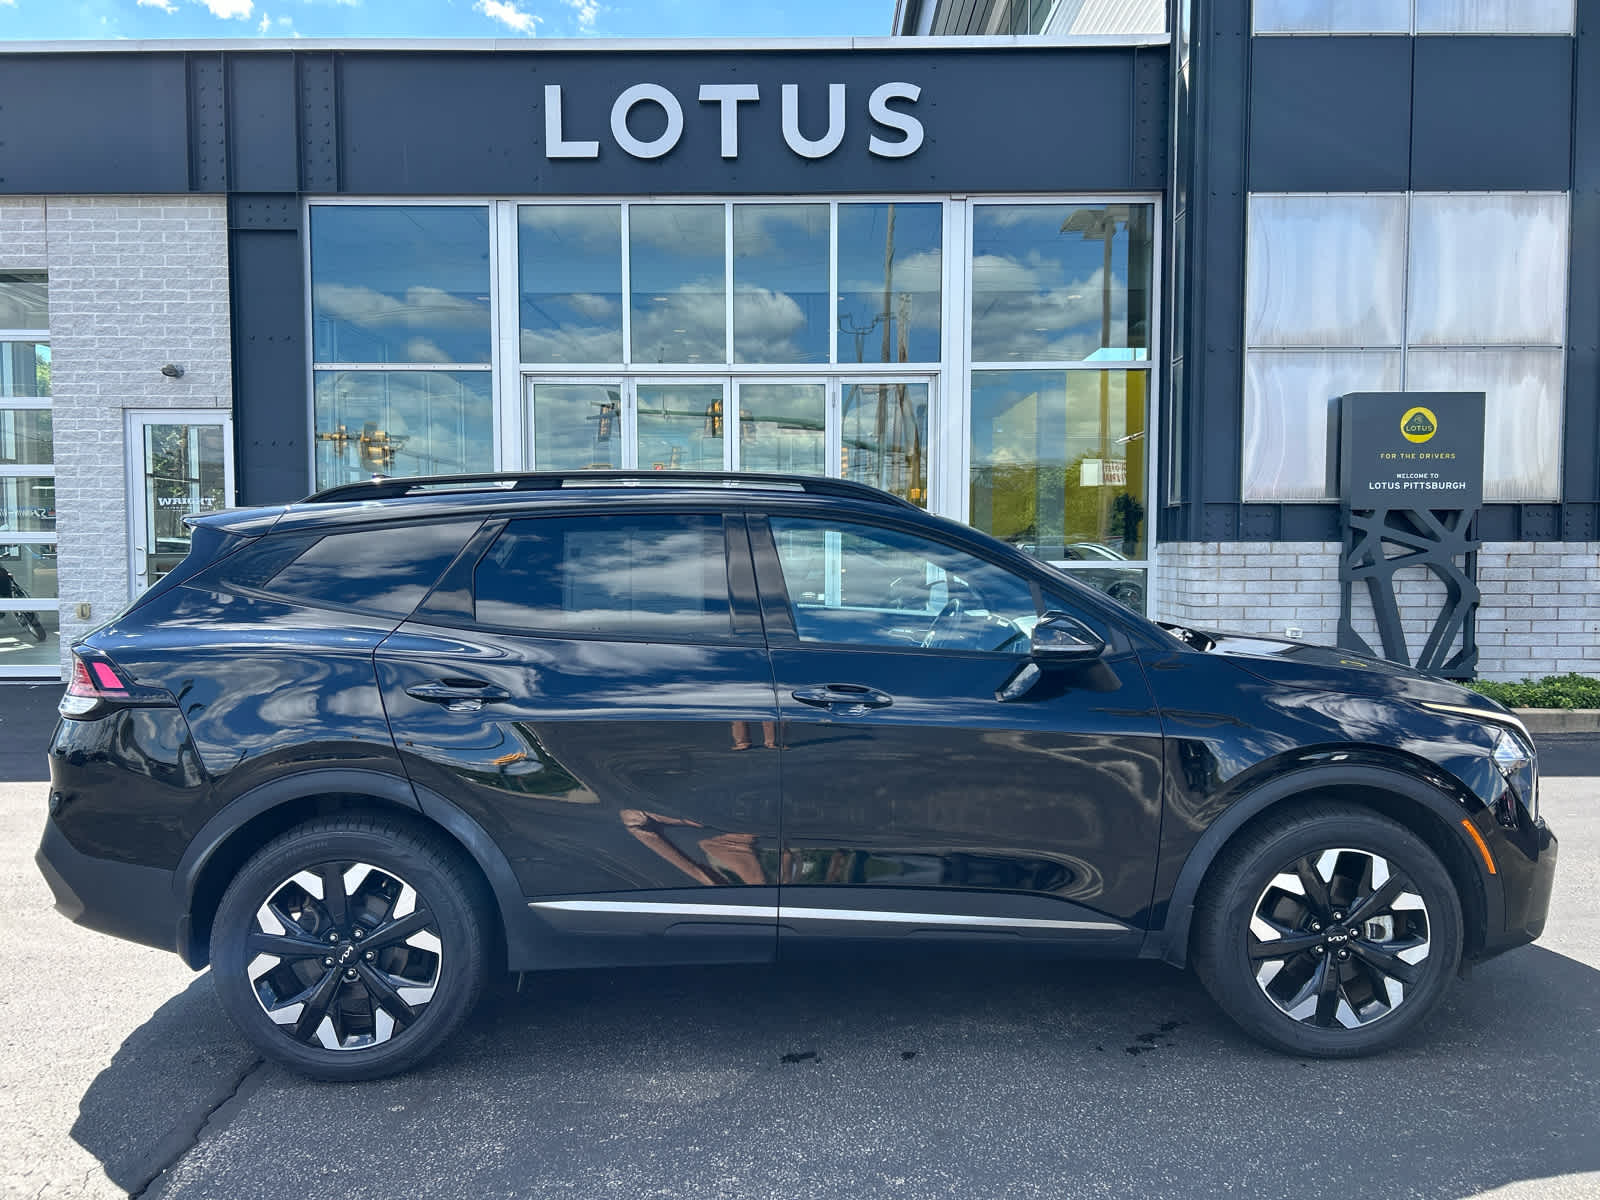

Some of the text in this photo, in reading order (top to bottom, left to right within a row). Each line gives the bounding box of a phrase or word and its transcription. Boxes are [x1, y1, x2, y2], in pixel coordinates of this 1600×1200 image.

[544, 82, 925, 159] LOTUS
[1405, 424, 1433, 432] LOTUS
[1369, 481, 1466, 490] LOTUS PITTSBURGH
